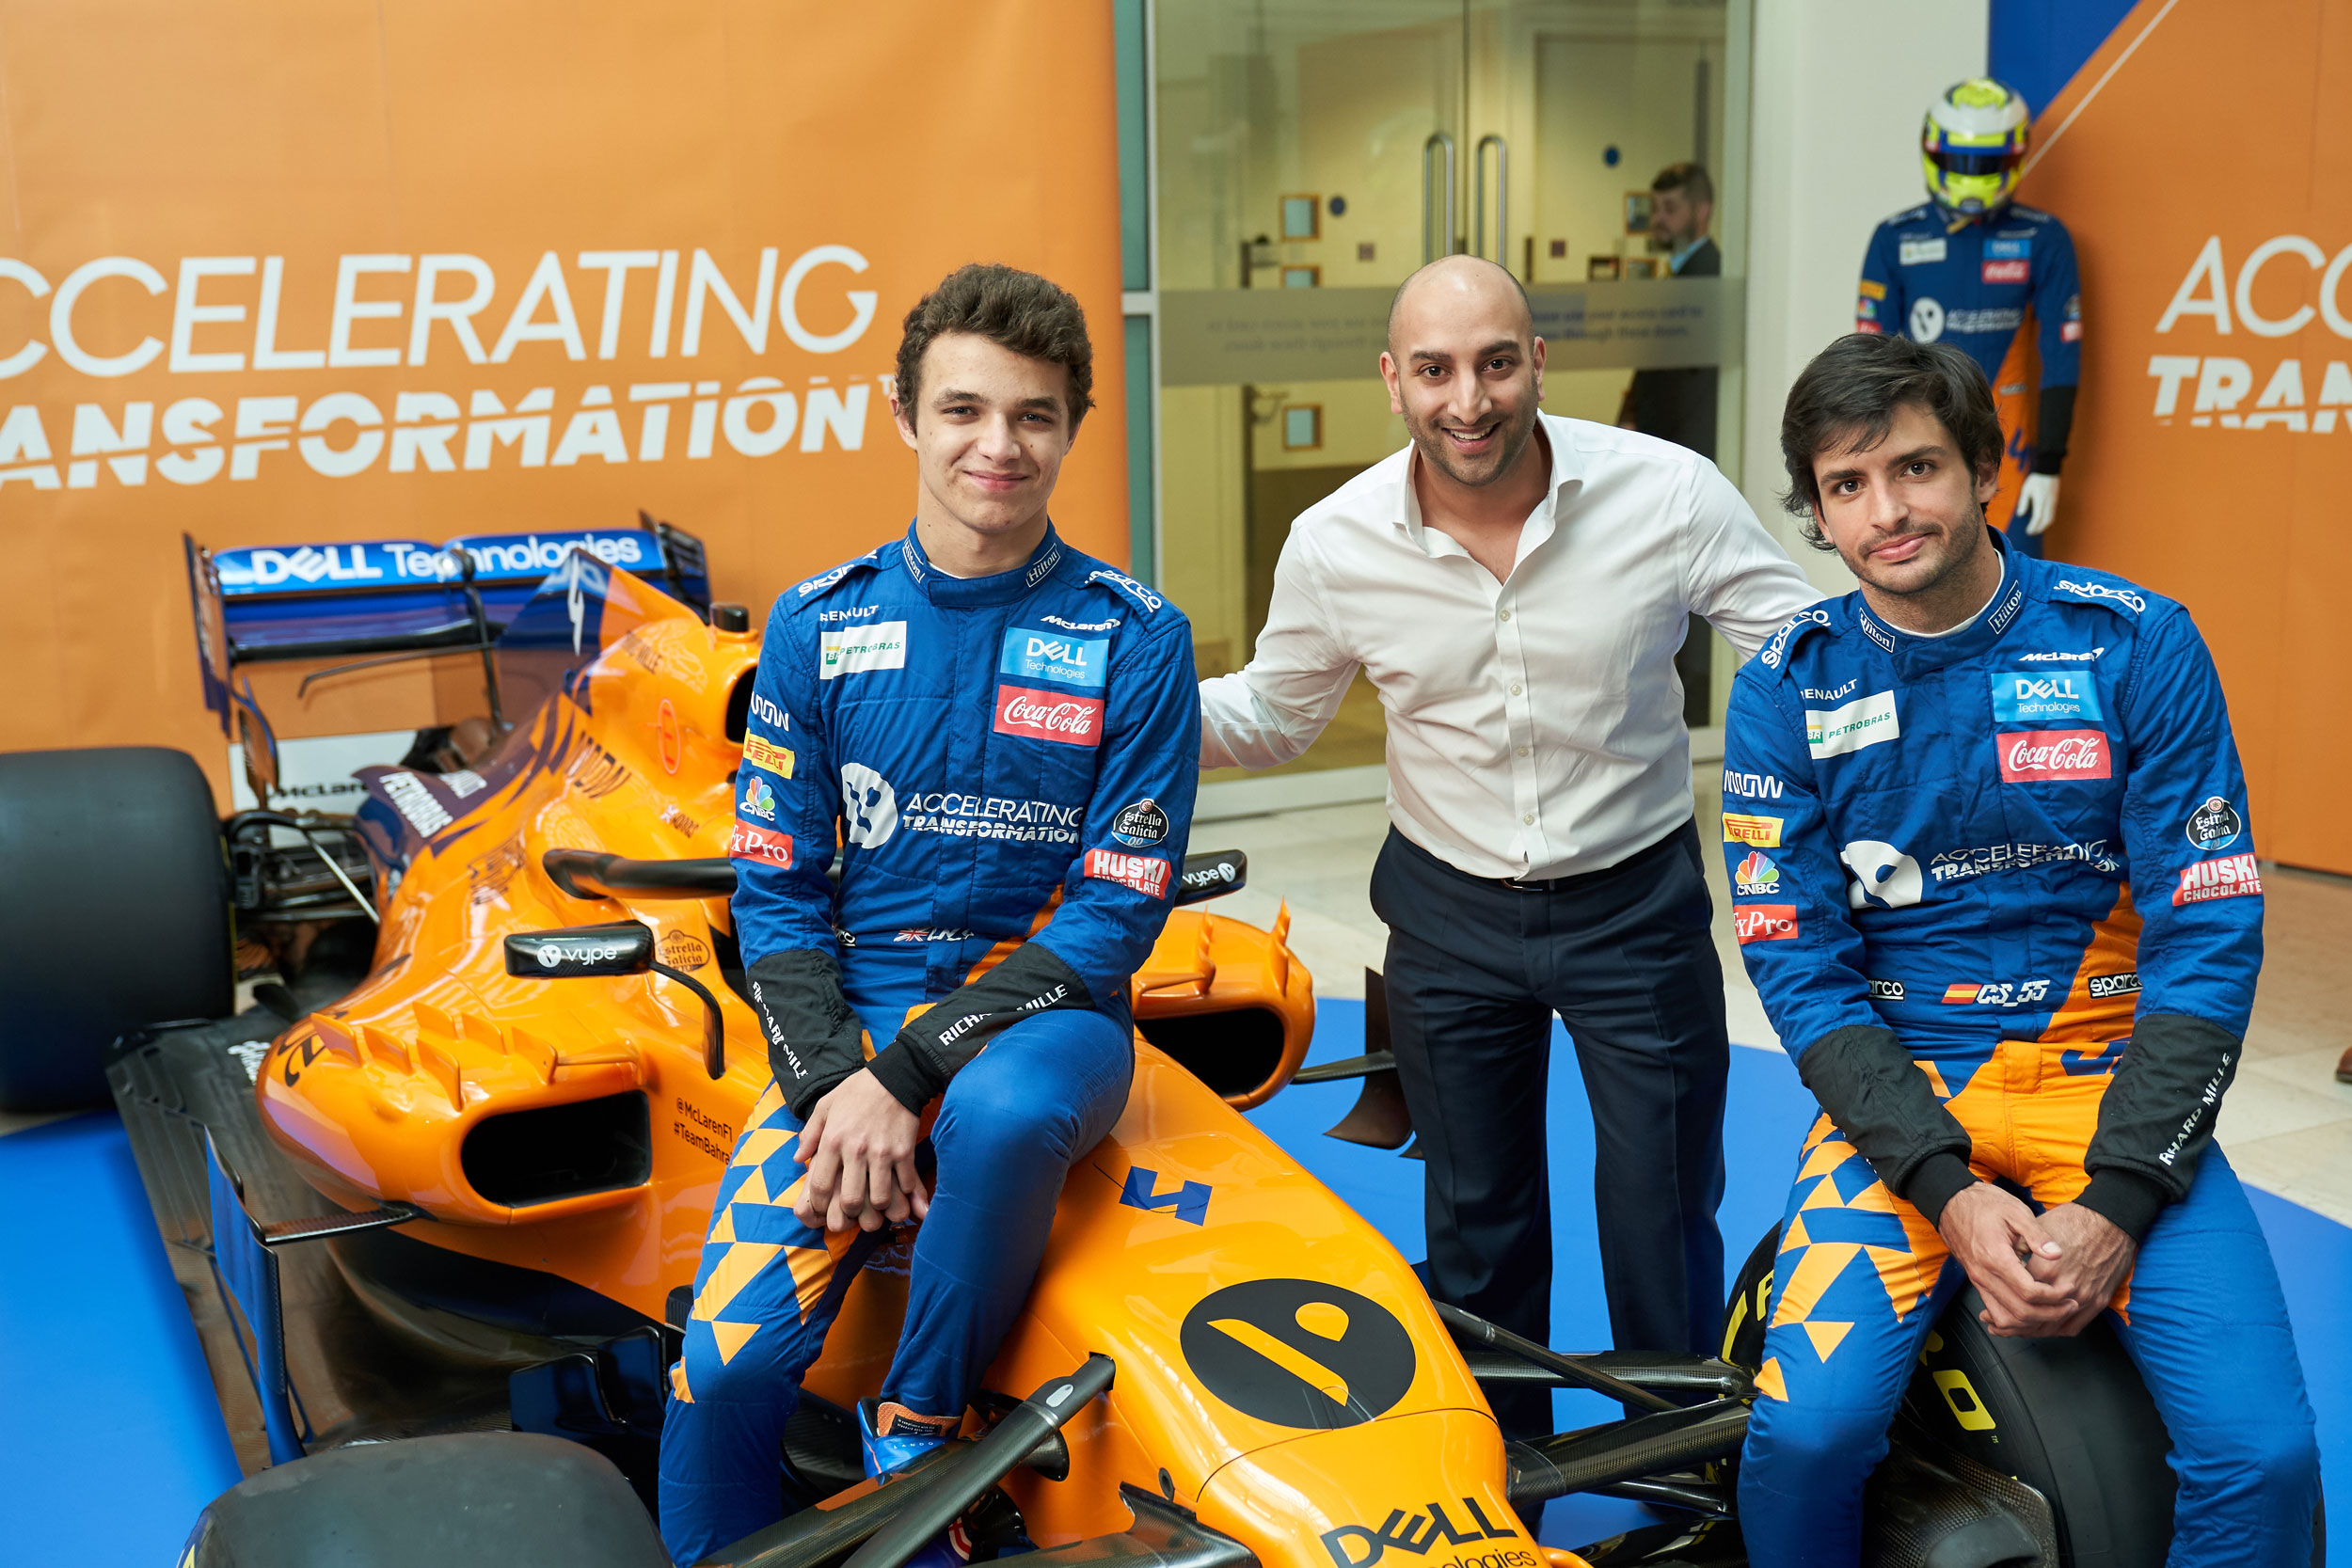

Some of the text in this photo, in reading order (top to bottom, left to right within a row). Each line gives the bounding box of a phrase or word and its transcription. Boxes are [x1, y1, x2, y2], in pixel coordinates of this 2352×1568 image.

[251, 533, 643, 582] DELL Tenologies
[1026, 549, 1057, 583] Hilton
[1025, 637, 1088, 667] DELL
[1760, 610, 1831, 670] sparco
[1025, 658, 1086, 679] Technologies
[2014, 678, 2079, 700] DELL
[1003, 695, 1097, 735] Coca-Cola
[2017, 702, 2081, 713] Technologies
[1828, 711, 1891, 739] PETROBRAS
[2008, 736, 2101, 772] Coca-Cola
[739, 801, 775, 822] CNBC
[1119, 822, 1159, 839] Galicia
[1093, 850, 1167, 885] HUSKI
[1182, 867, 1220, 887] vype
[2183, 854, 2259, 891] HUSKI
[1737, 882, 1780, 895] CNBC
[2183, 880, 2263, 903] CHOCOLATE
[564, 946, 618, 966] vype
[676, 1097, 733, 1143] @McLarenF1
[893, 1440, 934, 1450] LANDO
[1320, 1497, 1519, 1568] DELL
